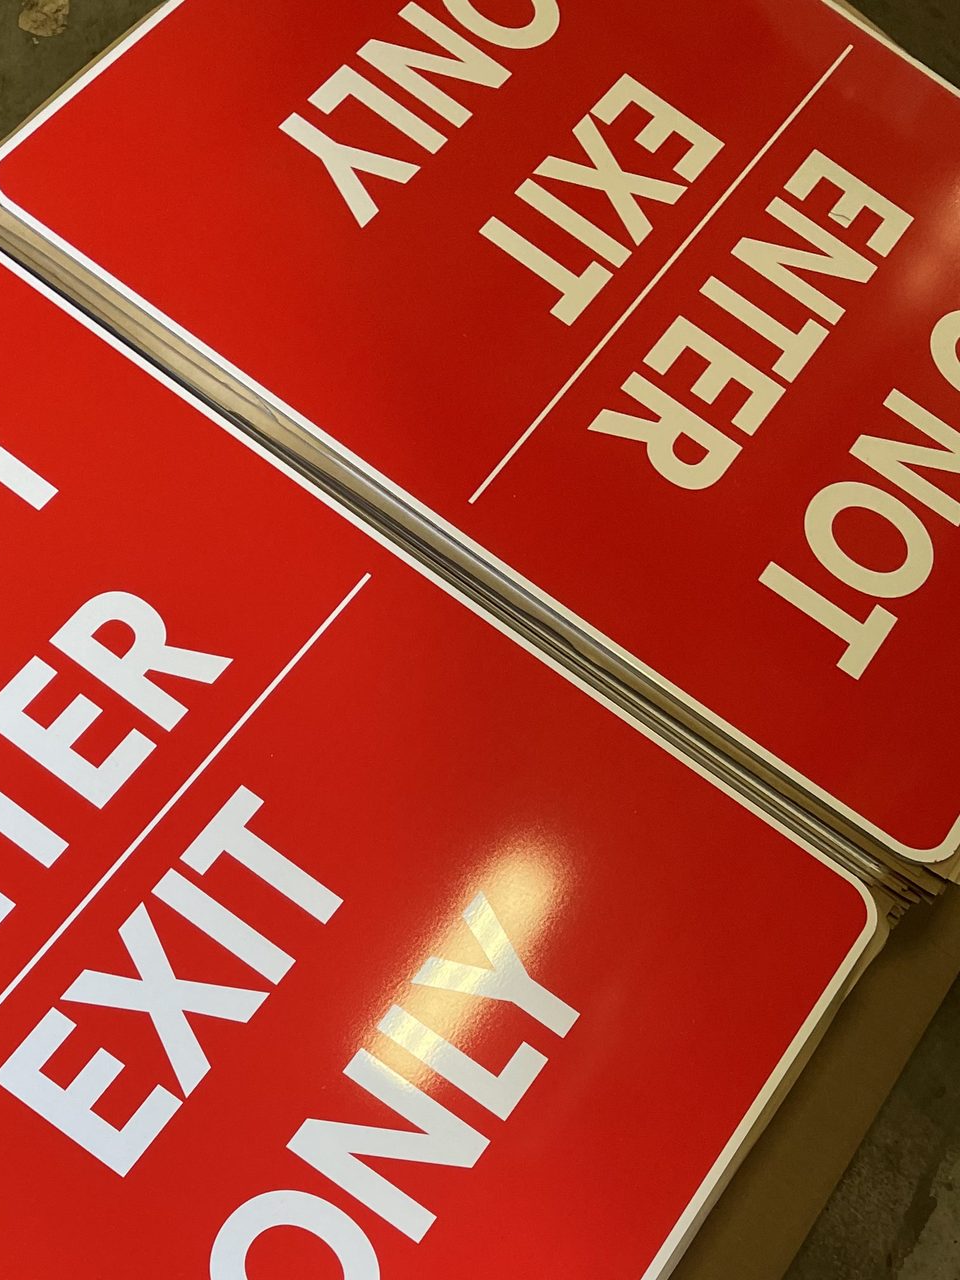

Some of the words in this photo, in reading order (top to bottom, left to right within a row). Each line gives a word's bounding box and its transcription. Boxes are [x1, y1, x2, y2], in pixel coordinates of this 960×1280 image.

[278, 0, 560, 228] ONLY
[478, 73, 725, 326] EXIT
[587, 149, 914, 490] ENTER
[758, 387, 960, 680] NOT
